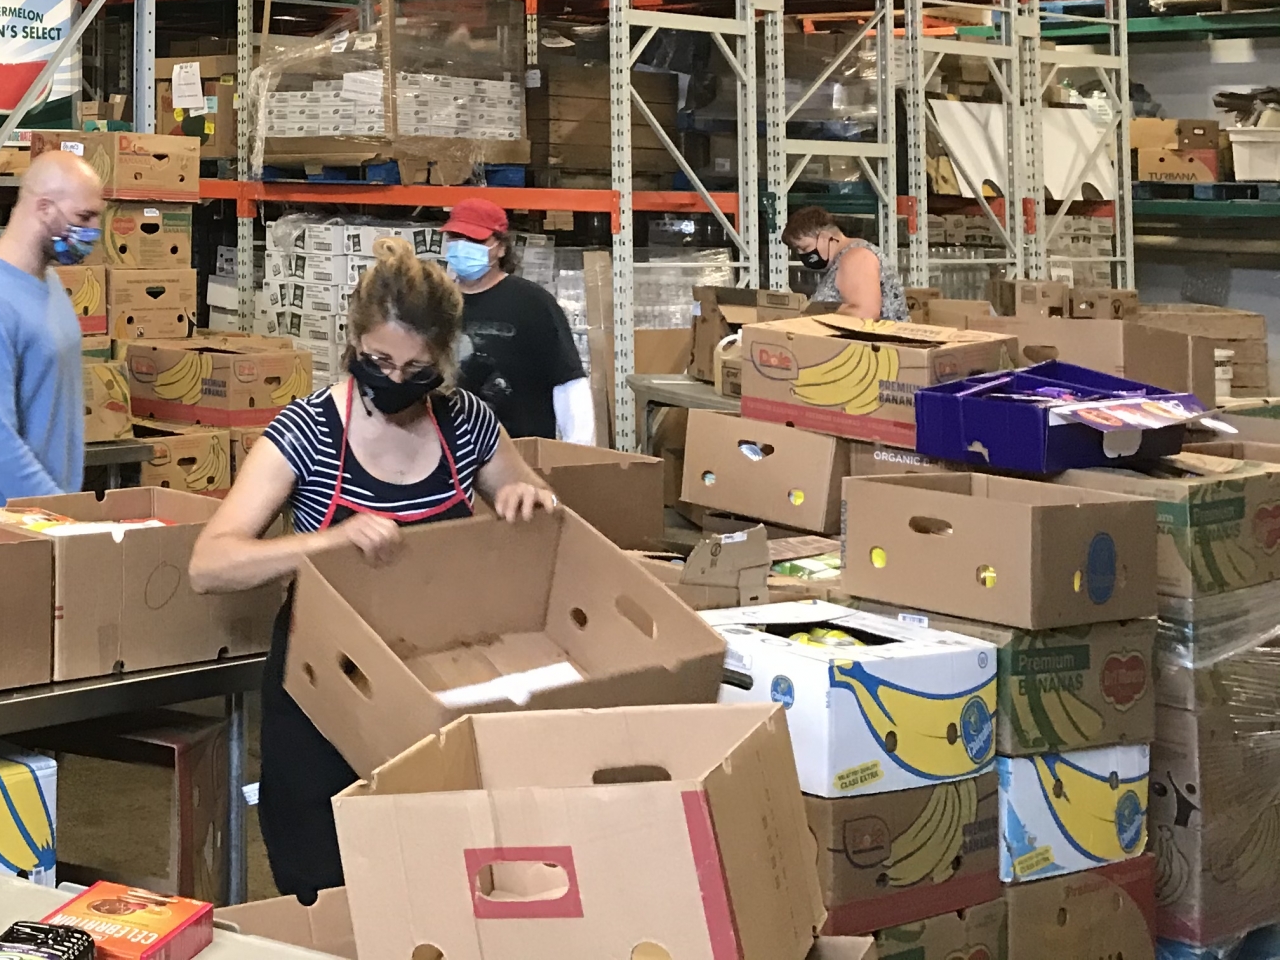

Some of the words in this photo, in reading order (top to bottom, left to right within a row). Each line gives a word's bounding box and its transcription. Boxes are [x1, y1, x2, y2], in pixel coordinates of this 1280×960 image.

[22, 26, 62, 41] SELECT
[1148, 172, 1197, 181] TURBANA
[759, 348, 792, 368] Dole
[939, 361, 958, 374] Dole
[878, 392, 915, 407] BANAN
[873, 450, 921, 466] ORGANIC
[1018, 654, 1075, 672] Premium
[772, 691, 793, 704] Chiquita
[968, 721, 992, 757] Chiquita
[860, 771, 880, 784] EXTRA
